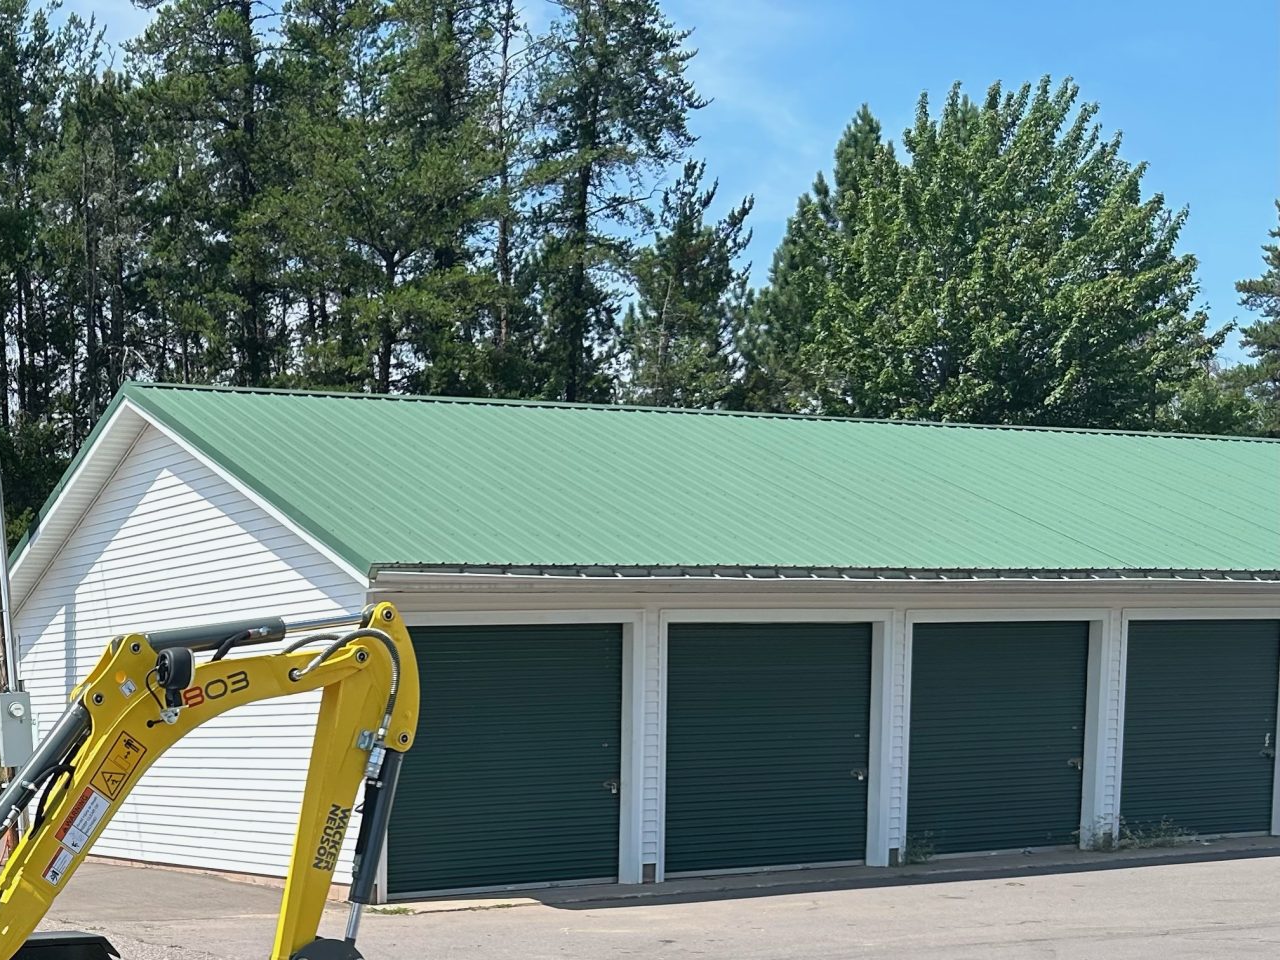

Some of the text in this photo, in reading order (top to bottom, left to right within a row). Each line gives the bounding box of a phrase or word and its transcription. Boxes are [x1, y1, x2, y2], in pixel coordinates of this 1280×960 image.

[183, 670, 249, 708] 803
[64, 794, 89, 829] WARNING
[313, 804, 341, 869] NEUSON
[323, 808, 351, 871] WACKER
